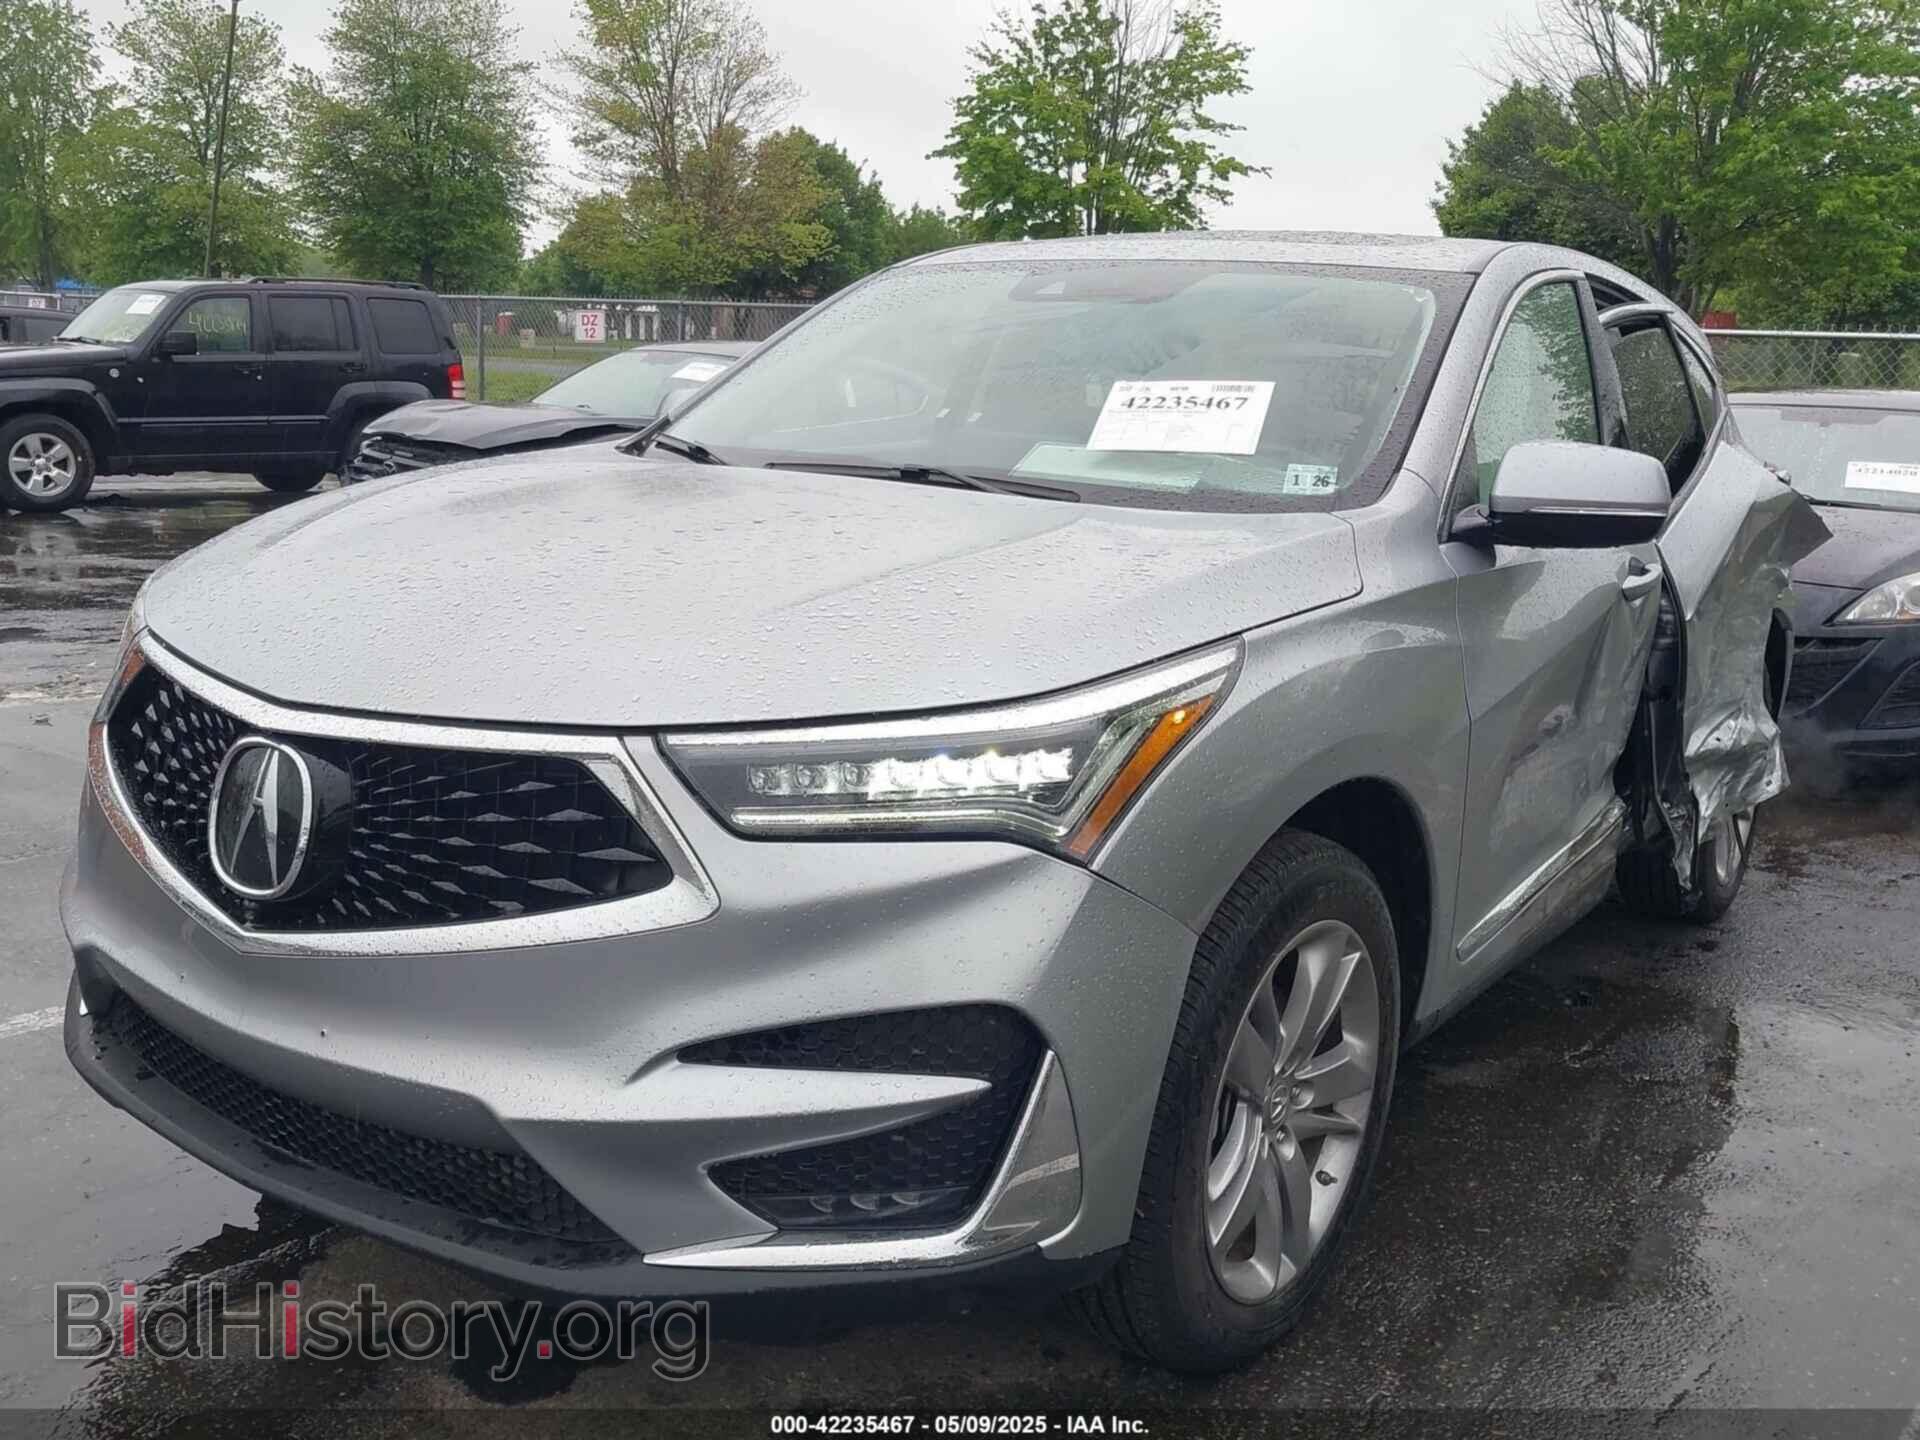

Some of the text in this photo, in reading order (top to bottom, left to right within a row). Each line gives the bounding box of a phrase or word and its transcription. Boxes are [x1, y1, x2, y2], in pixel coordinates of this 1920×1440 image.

[581, 314, 598, 326] DZ
[584, 328, 596, 338] 12
[1120, 396, 1248, 409] 42235467
[1292, 474, 1331, 488] 1 26
